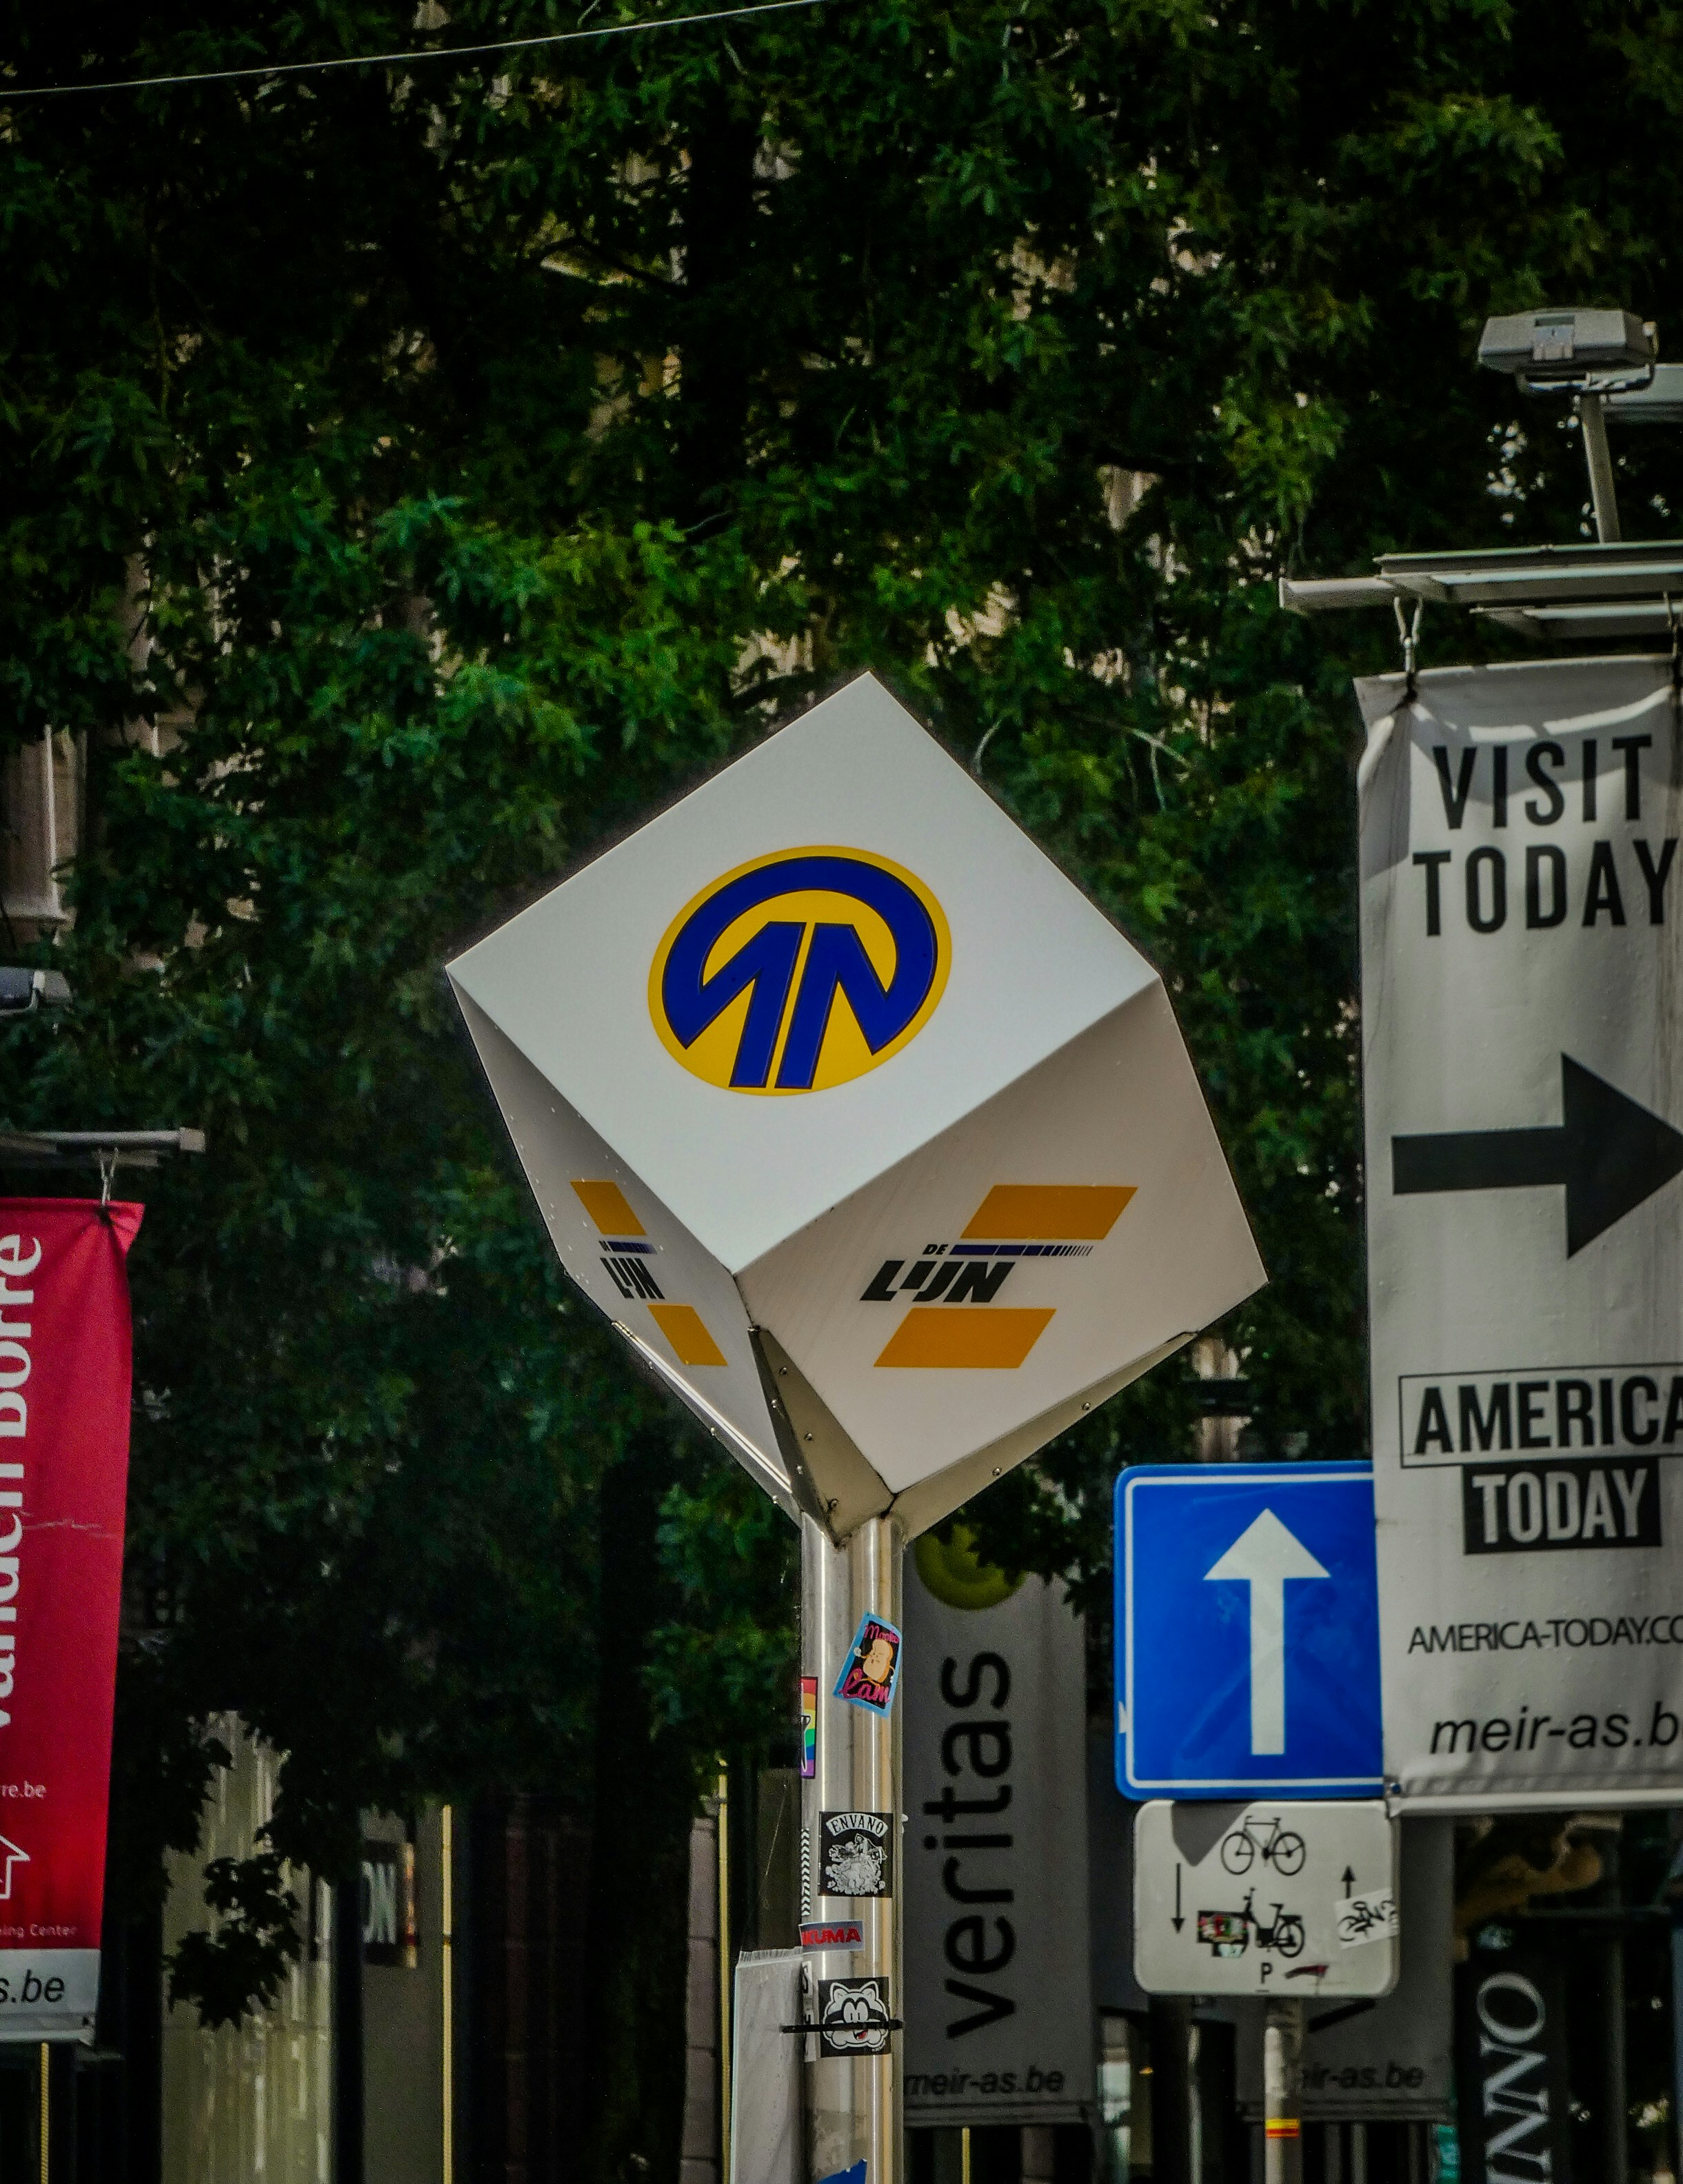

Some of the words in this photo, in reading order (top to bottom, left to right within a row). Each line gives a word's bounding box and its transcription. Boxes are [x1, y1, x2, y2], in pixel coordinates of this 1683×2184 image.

[1433, 734, 1652, 829] VISIT
[1412, 838, 1679, 937] TODAY
[922, 1244, 949, 1255] DE
[859, 1260, 1016, 1303] LIJN
[1472, 1468, 1648, 1544] TODAY
[1429, 1700, 1683, 1755] meir-as.b
[0, 1780, 46, 1798] re.be
[831, 1814, 885, 1835] ENVANO
[922, 1651, 1016, 2040] veritas
[1261, 1962, 1273, 1984] P
